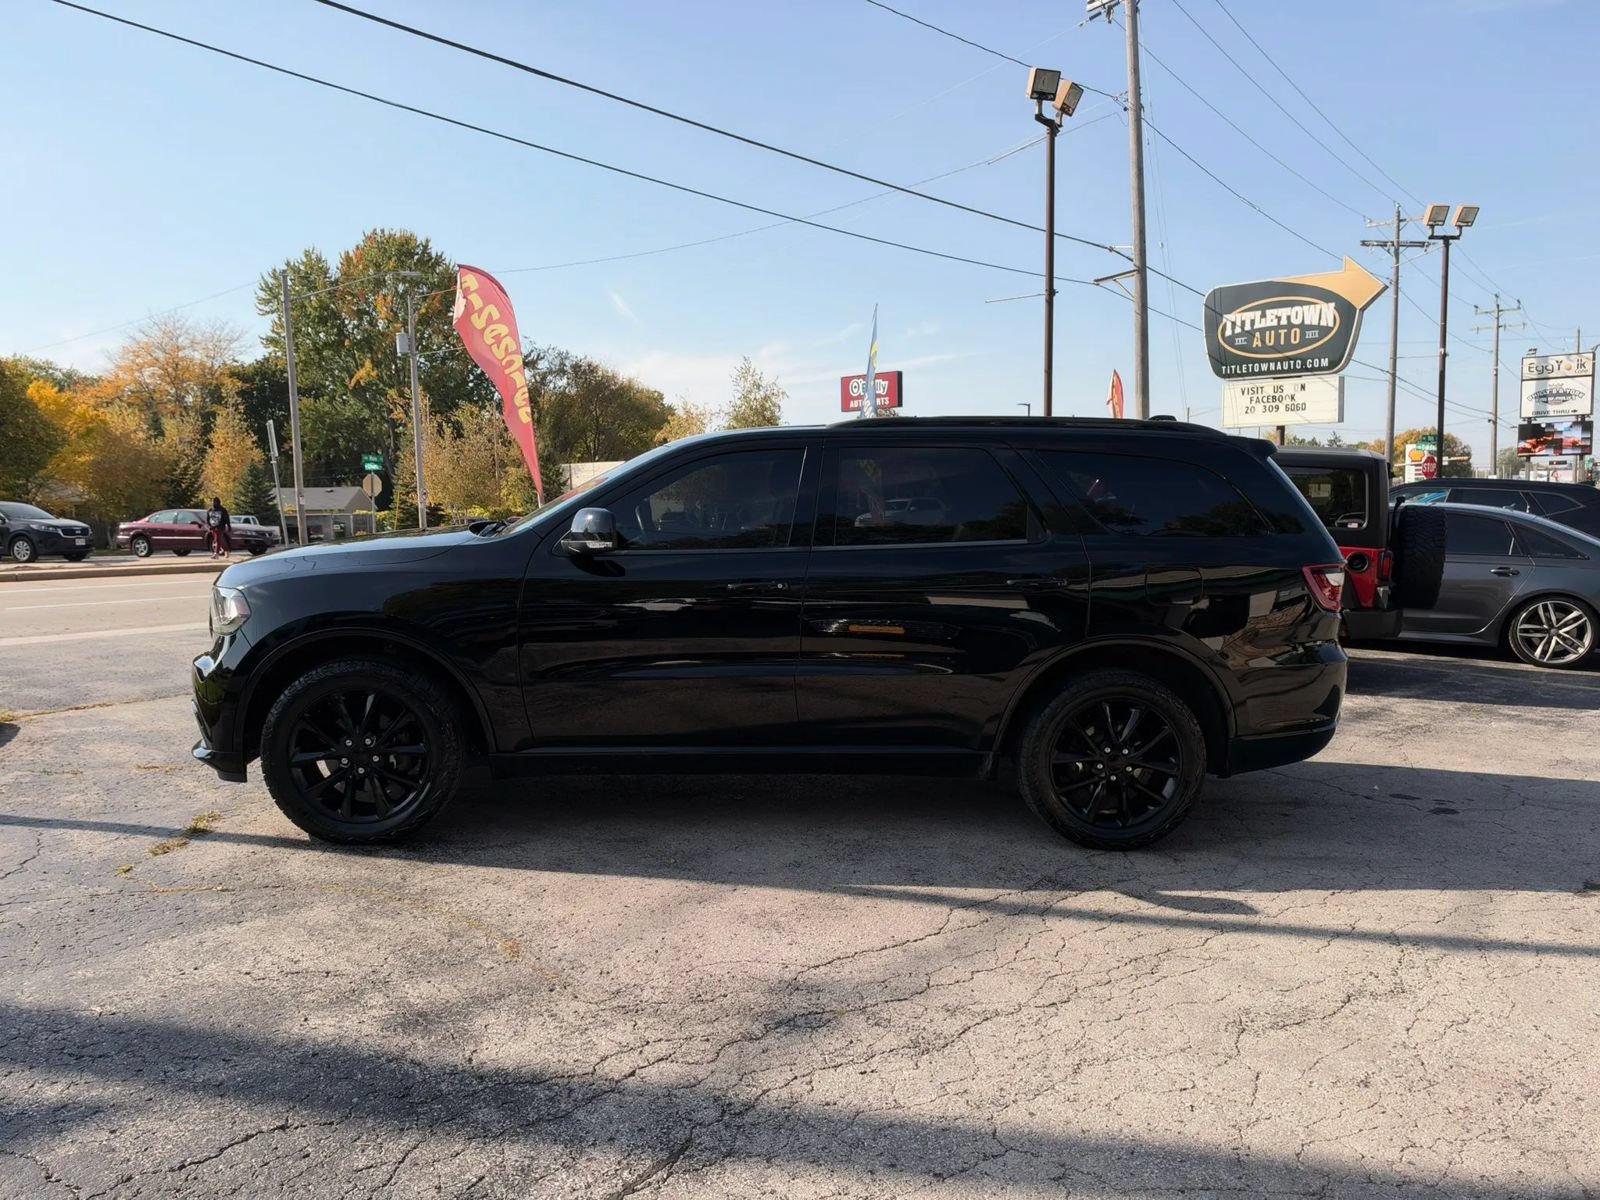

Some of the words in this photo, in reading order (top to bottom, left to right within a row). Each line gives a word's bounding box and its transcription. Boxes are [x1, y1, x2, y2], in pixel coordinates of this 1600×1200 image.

[1223, 302, 1336, 337] TITLETOWN
[1252, 328, 1301, 348] AUTO
[1221, 358, 1329, 374] TITLETOWNAUTO.COM
[1240, 386, 1265, 396] VISIT
[1273, 385, 1284, 394] US
[1294, 383, 1306, 392] ON
[850, 399, 864, 408] AUT
[1249, 393, 1296, 404] FACEBOOK
[1262, 404, 1280, 413] 309
[1423, 463, 1437, 473] STOP
